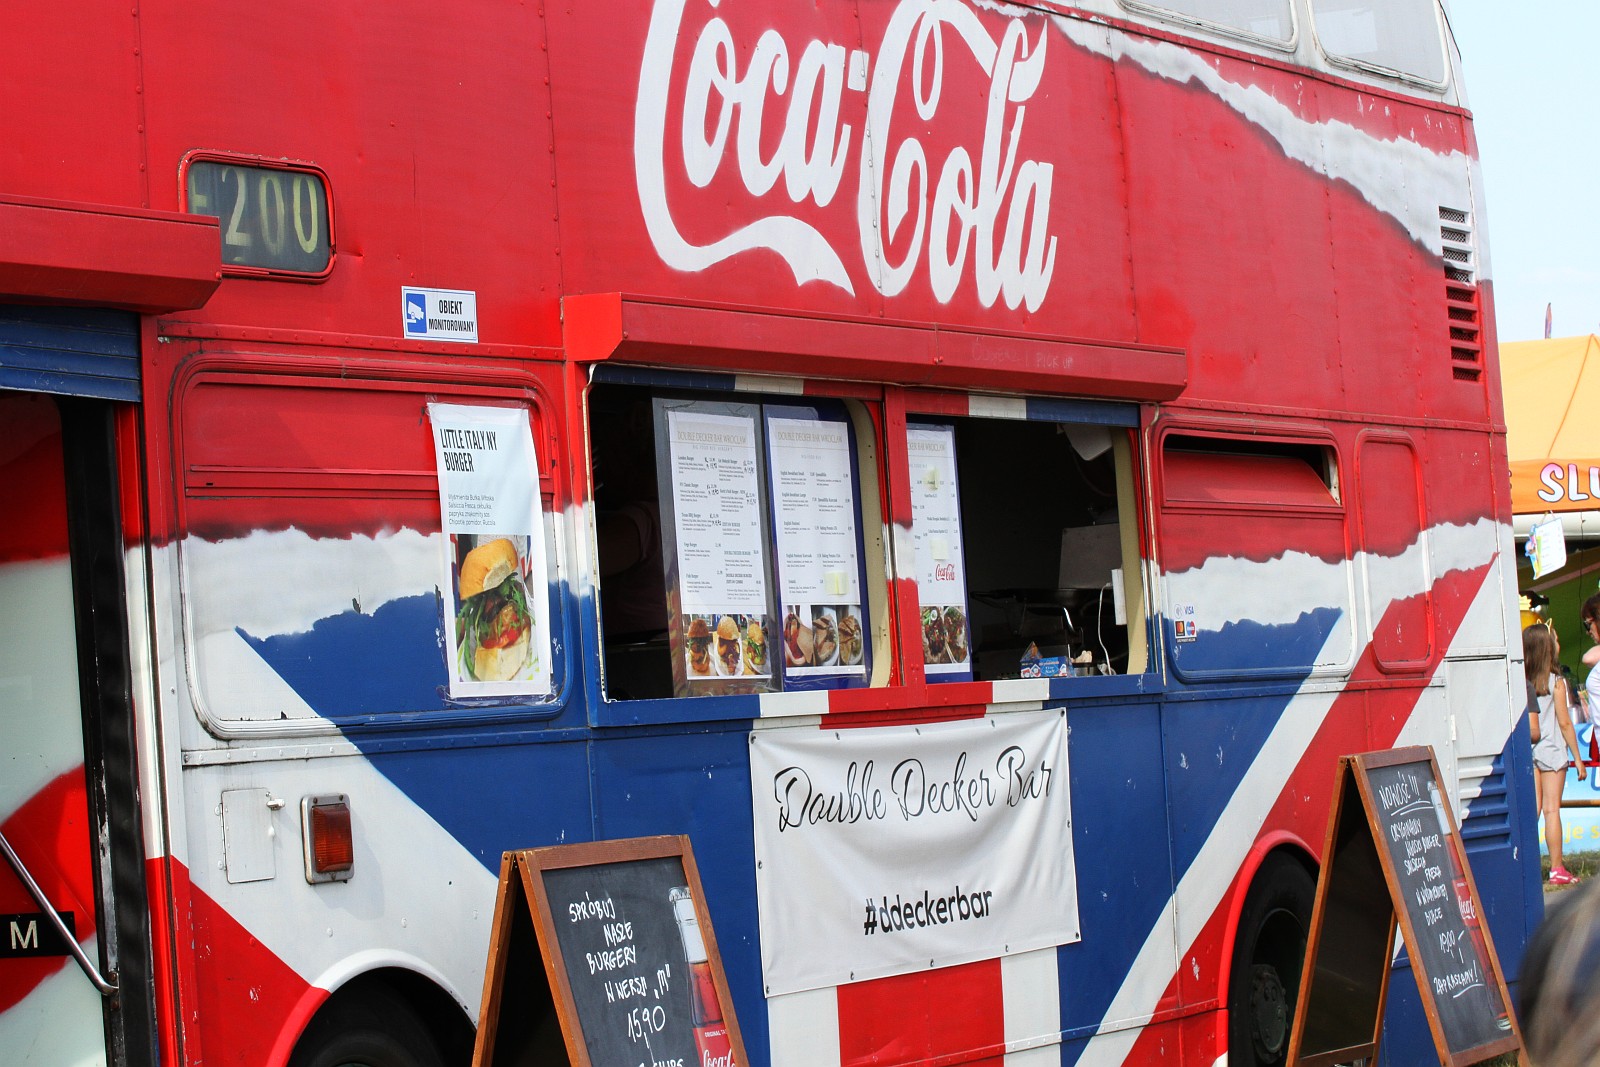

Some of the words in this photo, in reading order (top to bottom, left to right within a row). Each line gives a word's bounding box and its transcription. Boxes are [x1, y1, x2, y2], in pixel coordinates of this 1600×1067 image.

[438, 299, 463, 315] OBIEKT
[428, 318, 475, 333] MONITOROWANY
[439, 429, 465, 449] LITTLE
[464, 430, 486, 450] ITALY
[486, 431, 498, 451] NY
[443, 451, 475, 473] BURGER
[1183, 605, 1195, 615] VISA
[773, 759, 887, 832] Double
[891, 751, 998, 822] Decker
[996, 744, 1053, 808] Bar
[568, 891, 616, 923] SPRÓBUJ
[863, 885, 993, 935] #ddeckerbar
[9, 920, 39, 950] M
[603, 921, 634, 948] NASZE
[585, 945, 636, 975] BURGERY
